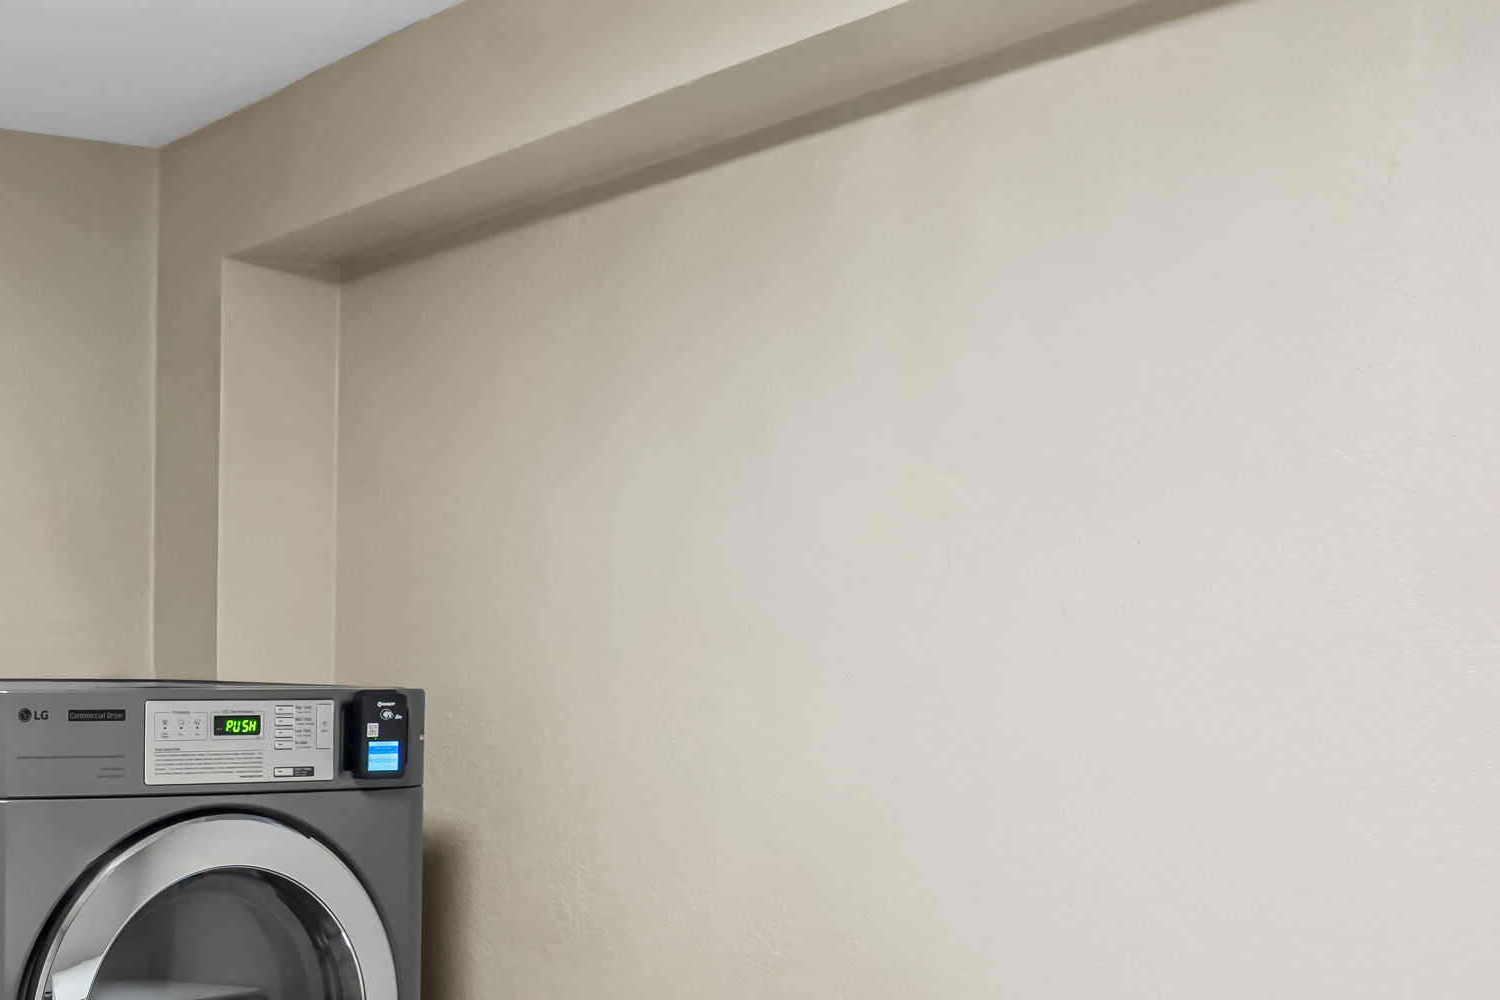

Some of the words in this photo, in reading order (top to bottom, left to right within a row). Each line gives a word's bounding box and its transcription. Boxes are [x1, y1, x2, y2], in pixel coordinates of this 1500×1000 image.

[34, 710, 49, 720] LG
[107, 712, 124, 720] Dryer
[225, 719, 258, 733] PUSH
